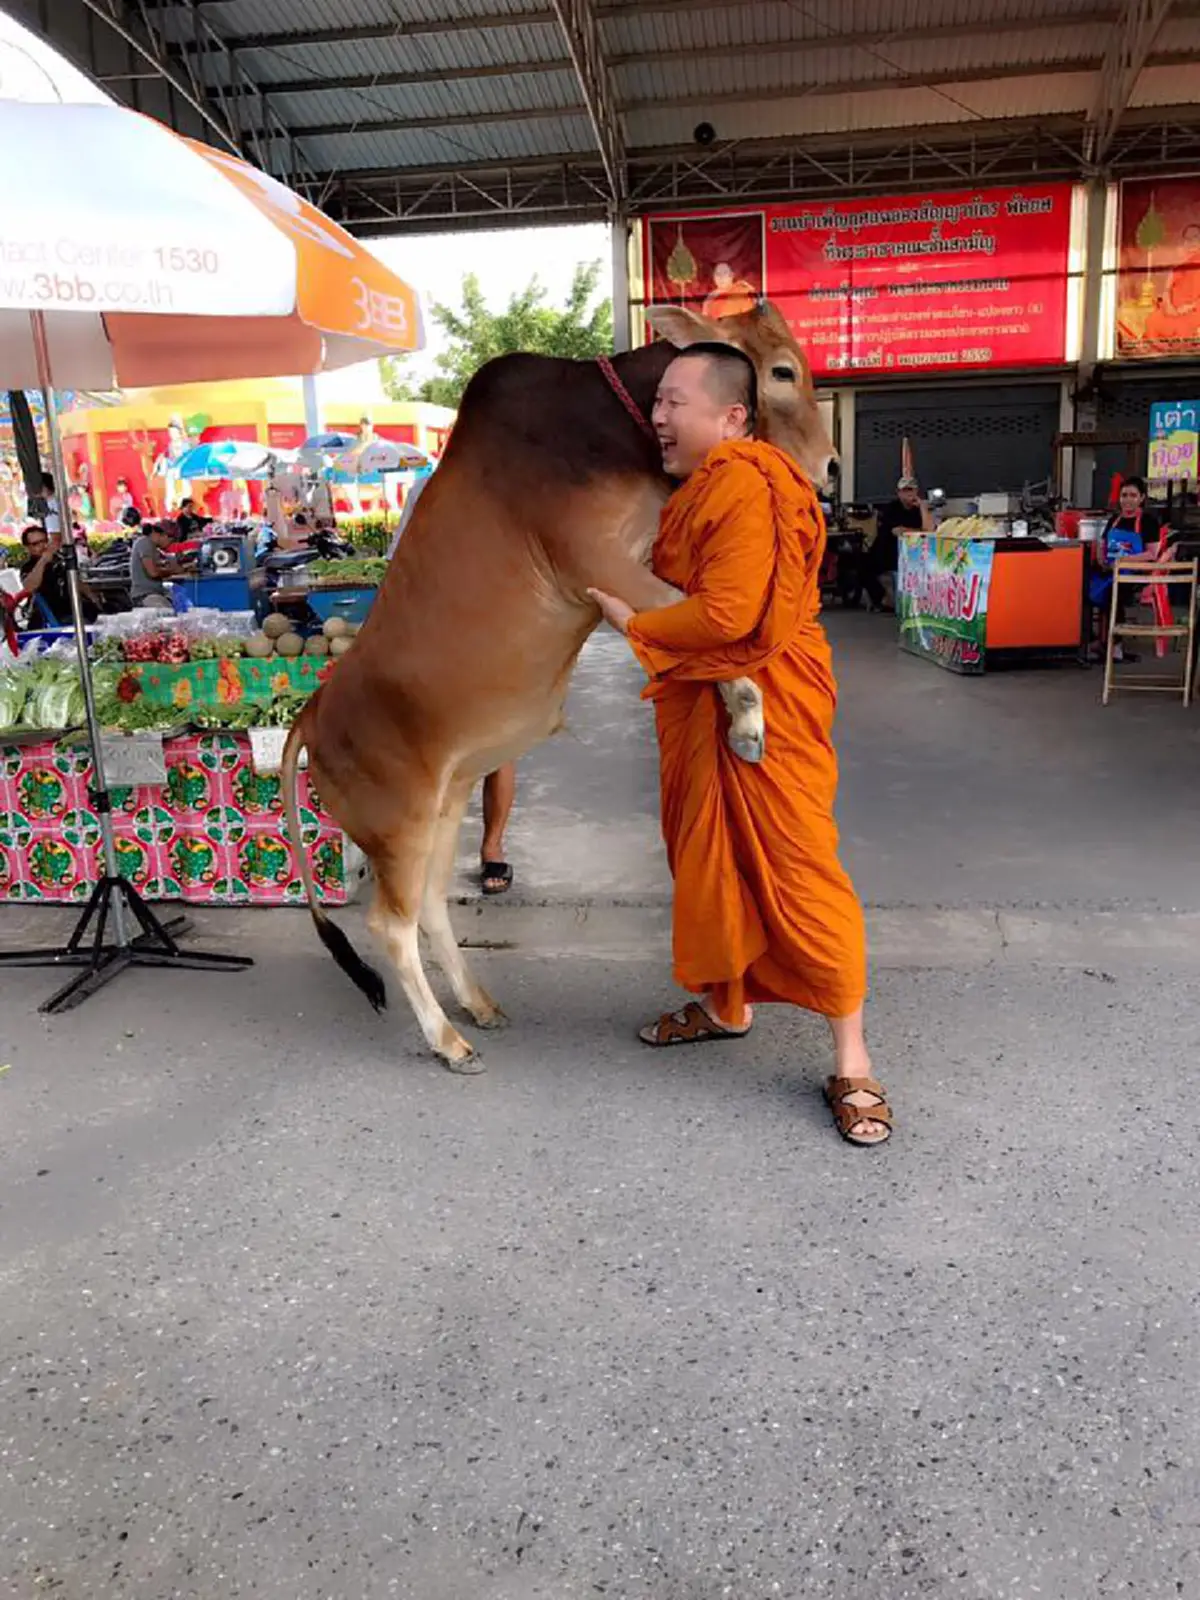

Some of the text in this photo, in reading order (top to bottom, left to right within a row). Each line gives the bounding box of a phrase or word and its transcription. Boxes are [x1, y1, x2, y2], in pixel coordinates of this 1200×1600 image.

[154, 245, 219, 275] 1530
[351, 276, 408, 331] 3BB
[1154, 401, 1197, 429] เต่า
